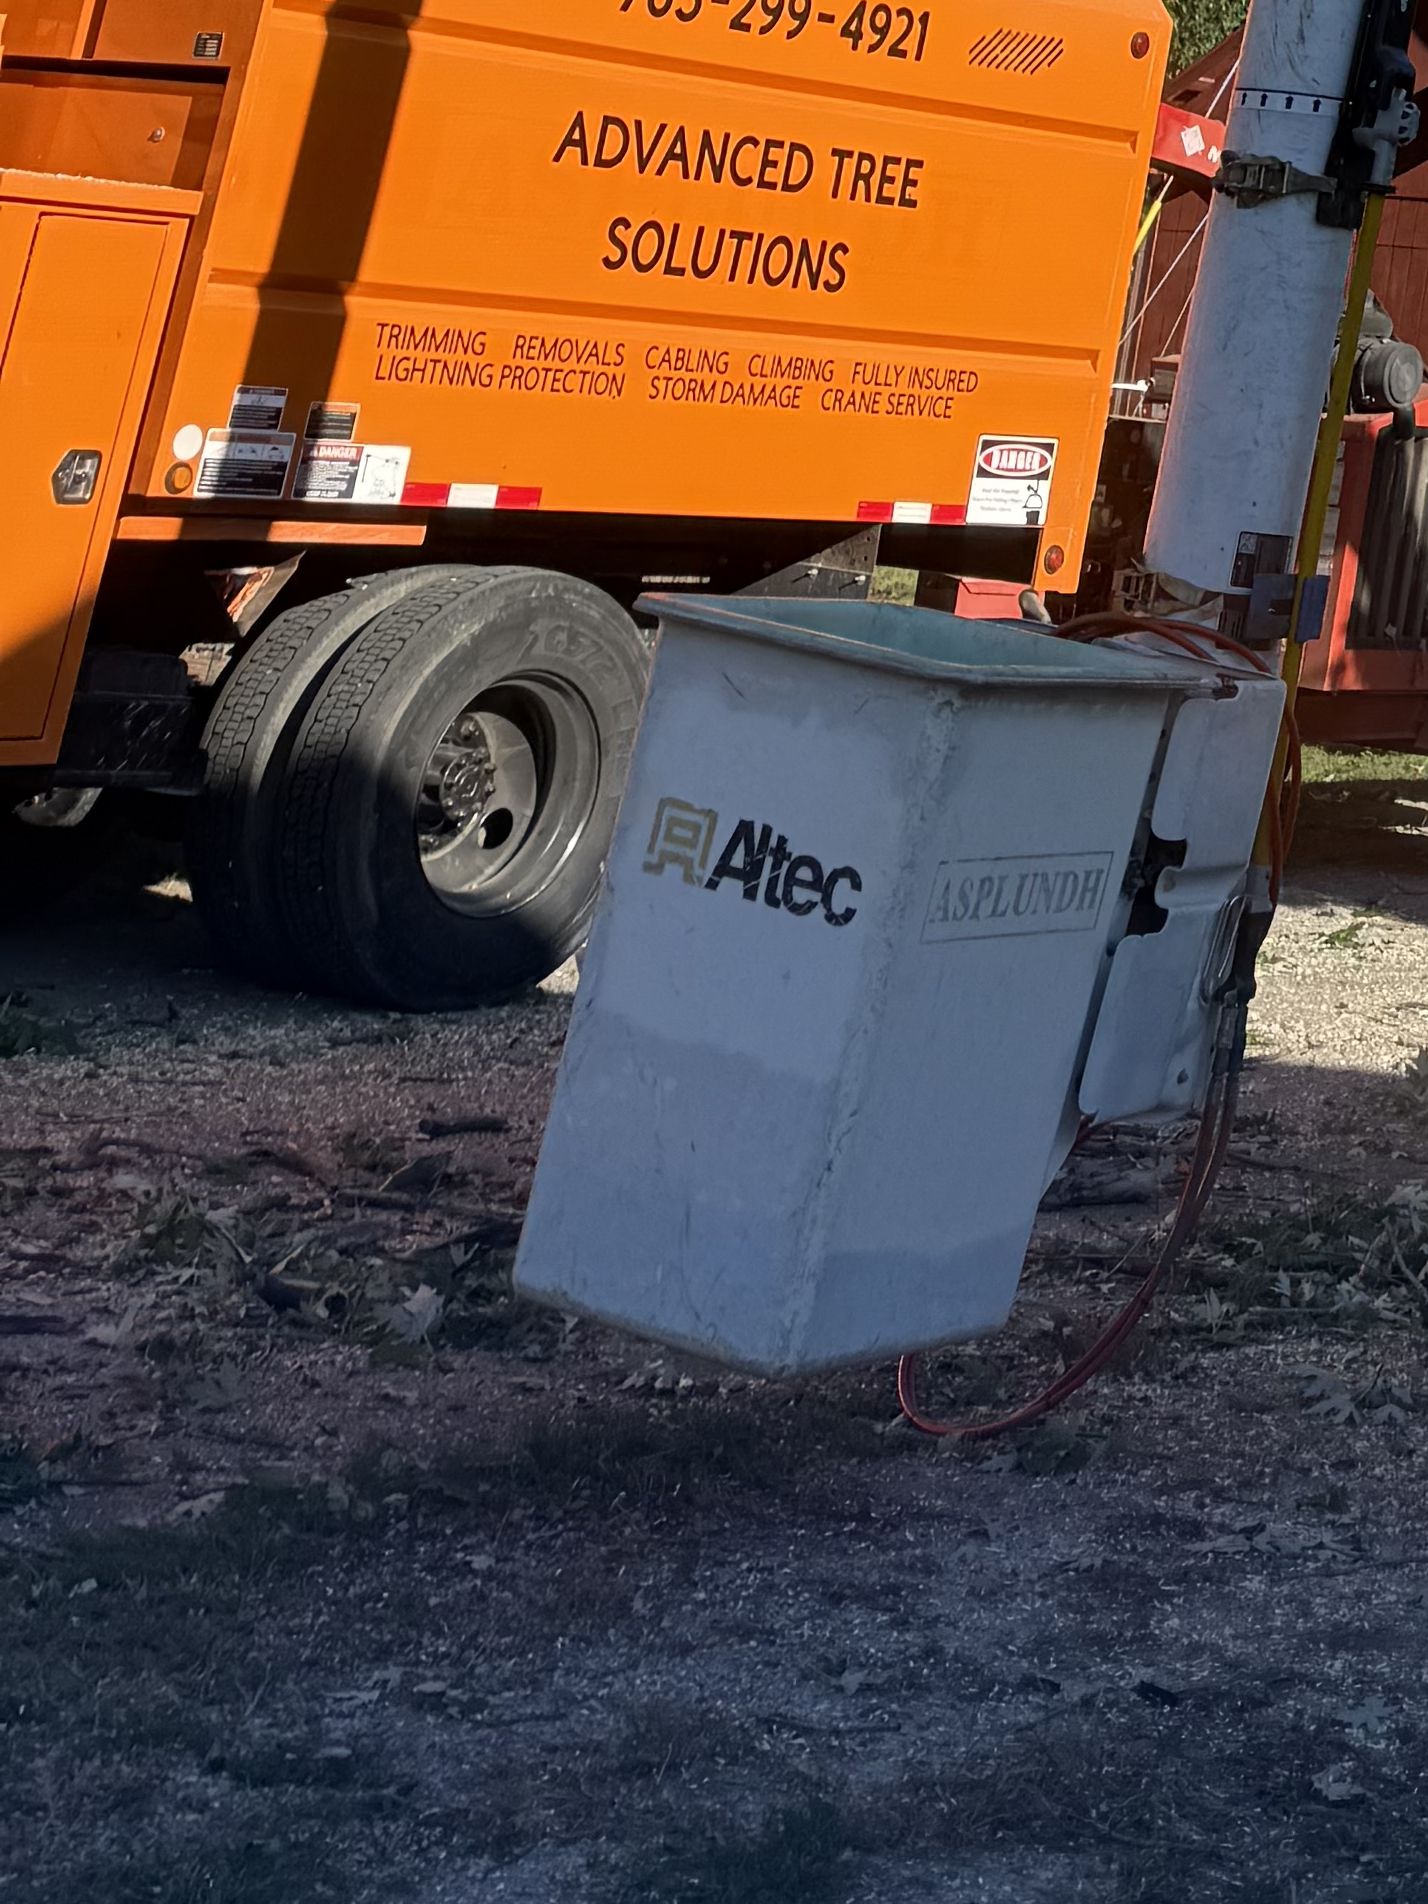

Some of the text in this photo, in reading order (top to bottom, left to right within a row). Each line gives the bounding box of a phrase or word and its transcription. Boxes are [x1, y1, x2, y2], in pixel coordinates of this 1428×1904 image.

[551, 110, 925, 209] ADVANCED TREE
[600, 215, 851, 294] SOLUTIONS
[374, 353, 955, 420] LIGHTNING PROTECTION STORM DAMAGE CRANE SERVICE
[375, 322, 979, 394] TRIMMING REMOVALS CABLING CLIMBING FULLY INSURED
[318, 446, 358, 459] DANGER
[991, 449, 1041, 470] DANGER
[703, 818, 864, 928] Altec
[928, 866, 1105, 924] ASPLUNDH
